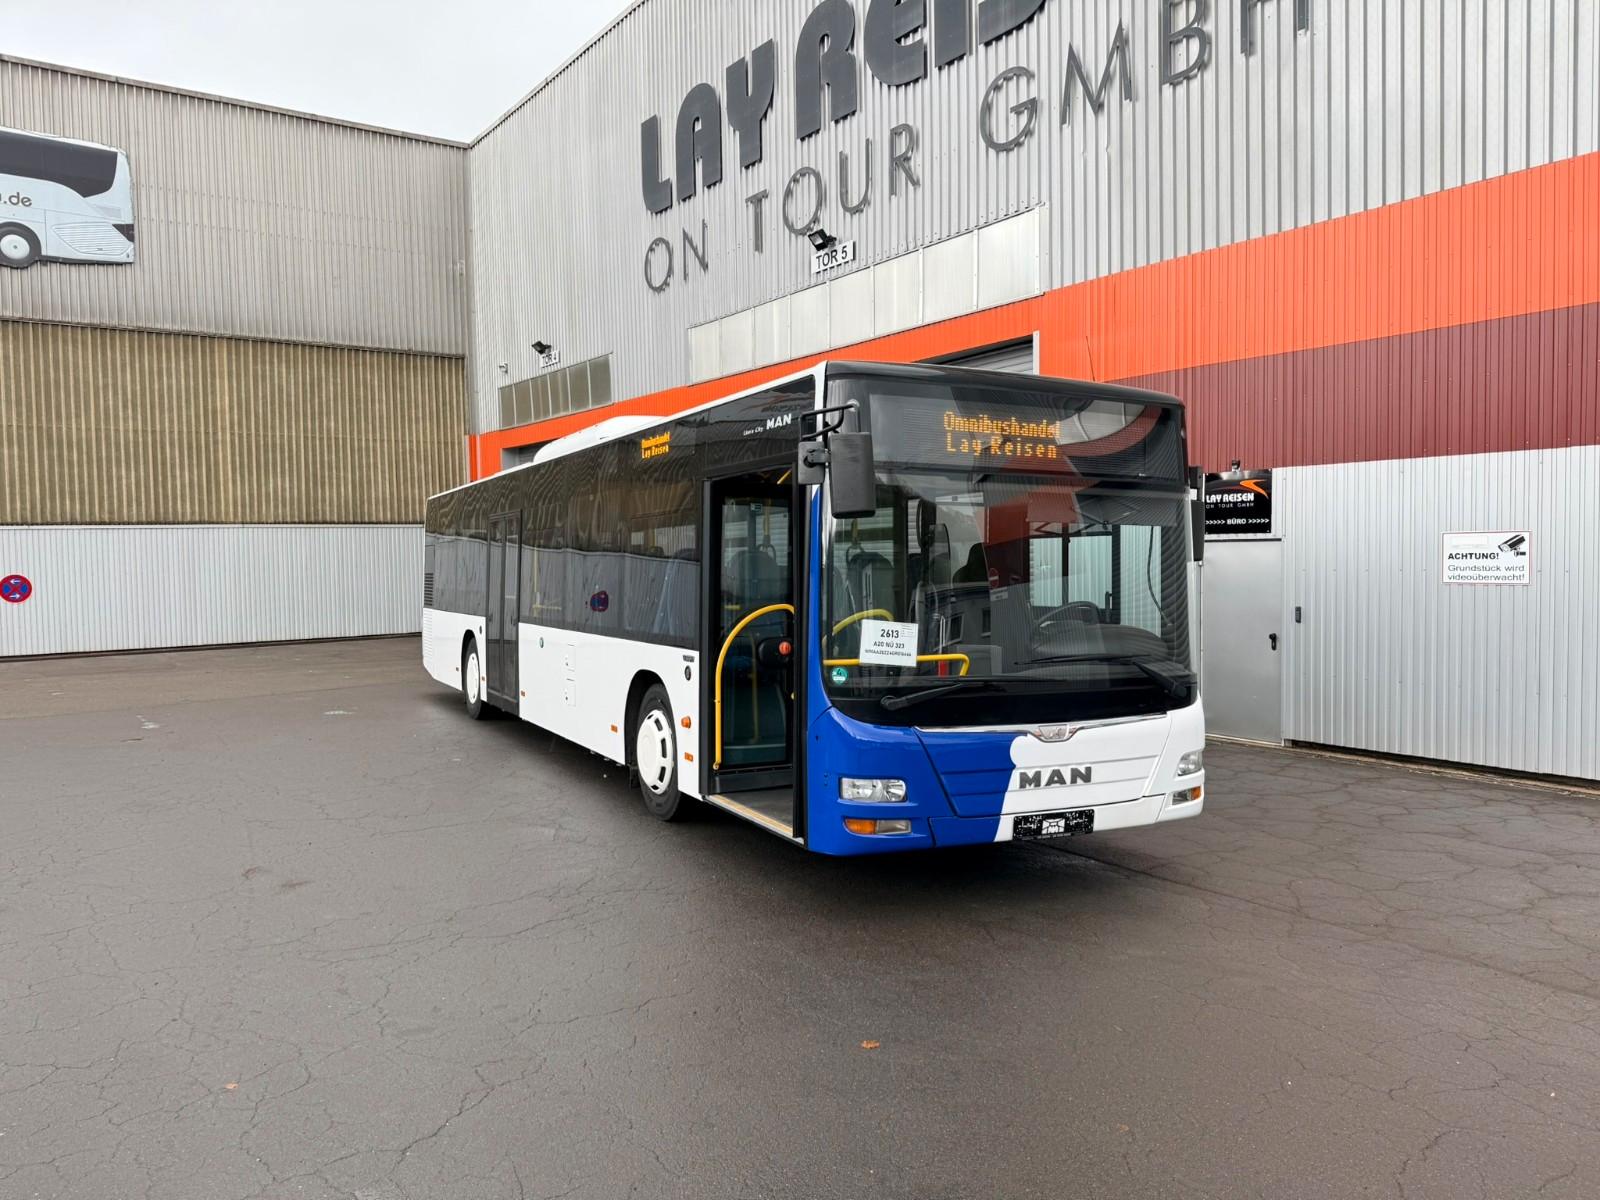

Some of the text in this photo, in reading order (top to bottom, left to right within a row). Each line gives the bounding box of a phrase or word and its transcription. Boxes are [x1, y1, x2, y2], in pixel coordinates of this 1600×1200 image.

[641, 38, 775, 213] LAY
[0, 192, 32, 207] .de
[644, 219, 708, 292] ON
[745, 123, 921, 253] TOUR
[815, 245, 847, 270] TOR 5
[766, 413, 792, 430] MAN
[943, 411, 1061, 439] Omnibushandel
[946, 432, 1057, 459] Lay Reisen
[1206, 493, 1254, 503] LAY REISEN
[1447, 552, 1500, 560] ACHTUNG!
[1447, 564, 1525, 572] Grundstück wird
[1447, 573, 1525, 581] videoüberwacht!
[880, 628, 900, 639] 2613
[1018, 766, 1092, 789] MAN
